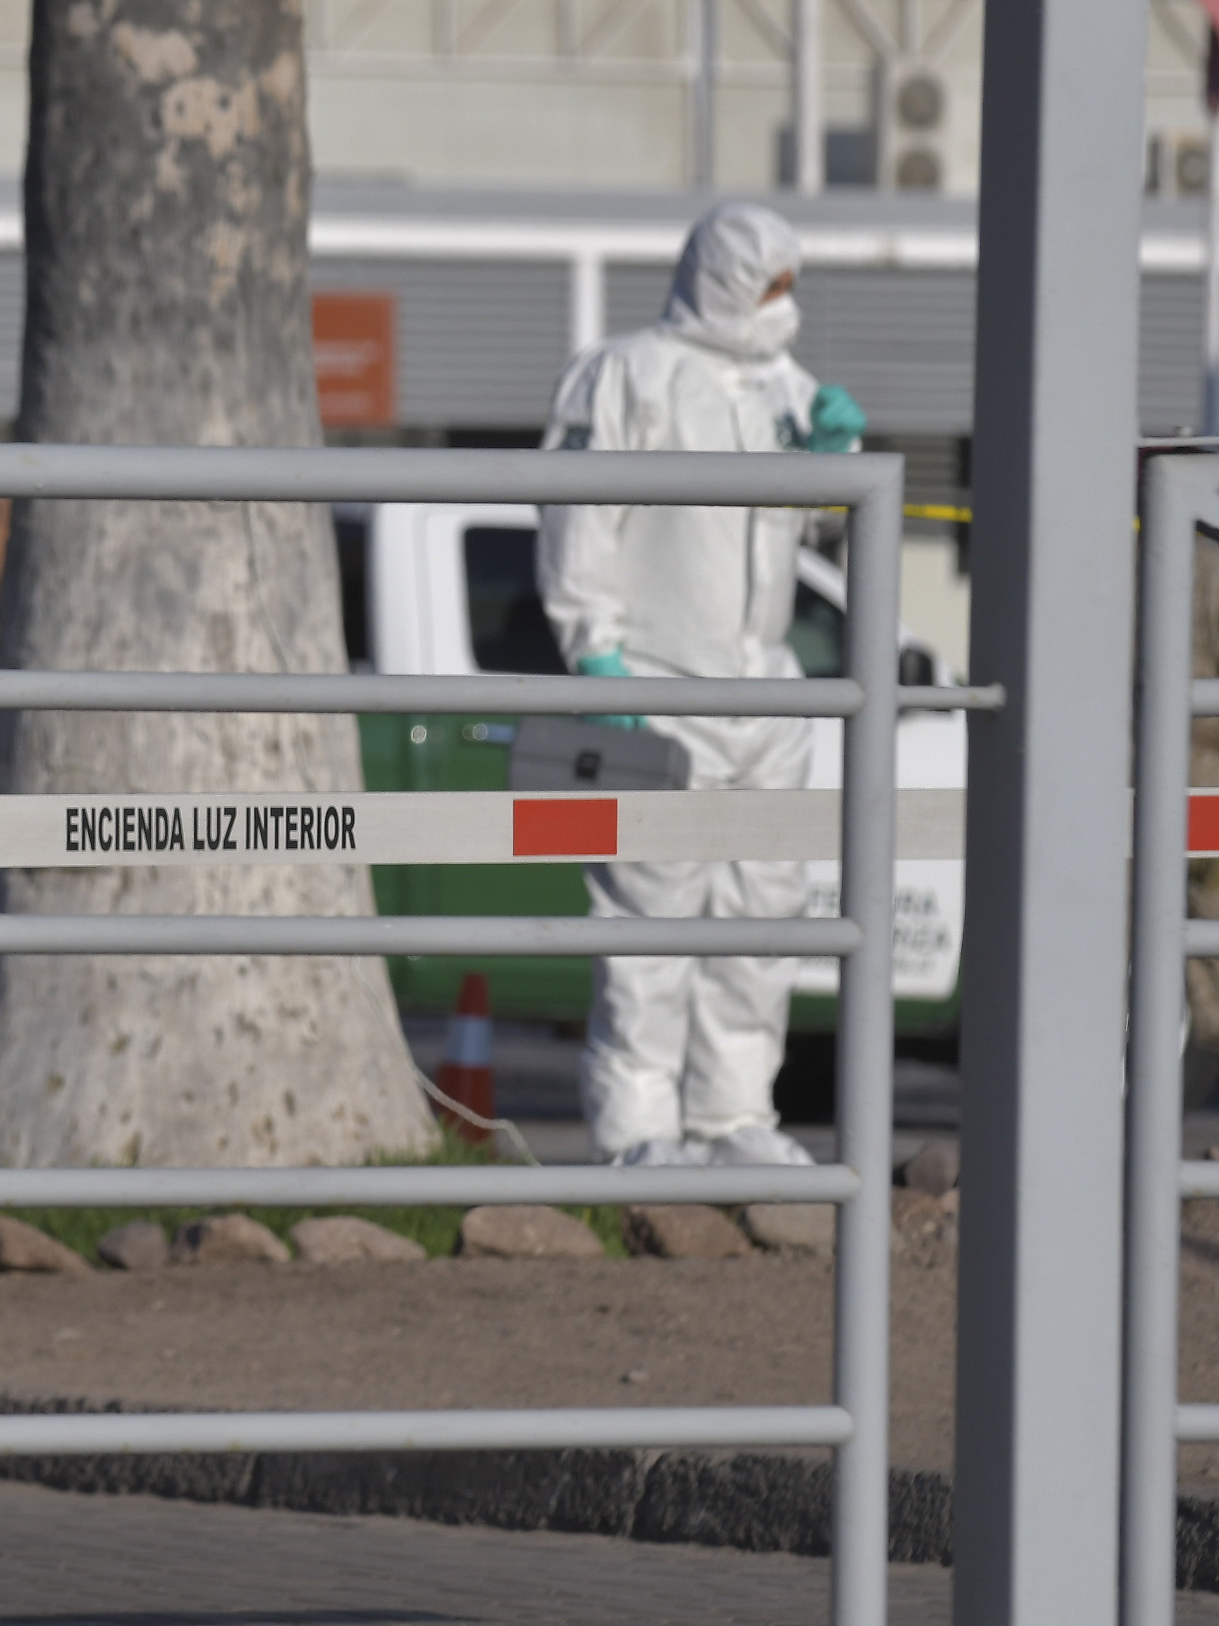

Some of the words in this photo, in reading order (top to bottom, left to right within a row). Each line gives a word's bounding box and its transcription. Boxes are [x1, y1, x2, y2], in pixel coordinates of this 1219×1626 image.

[66, 807, 184, 851] ENCIENDA
[193, 806, 237, 850] LUZ
[245, 805, 356, 850] INTERIOR
